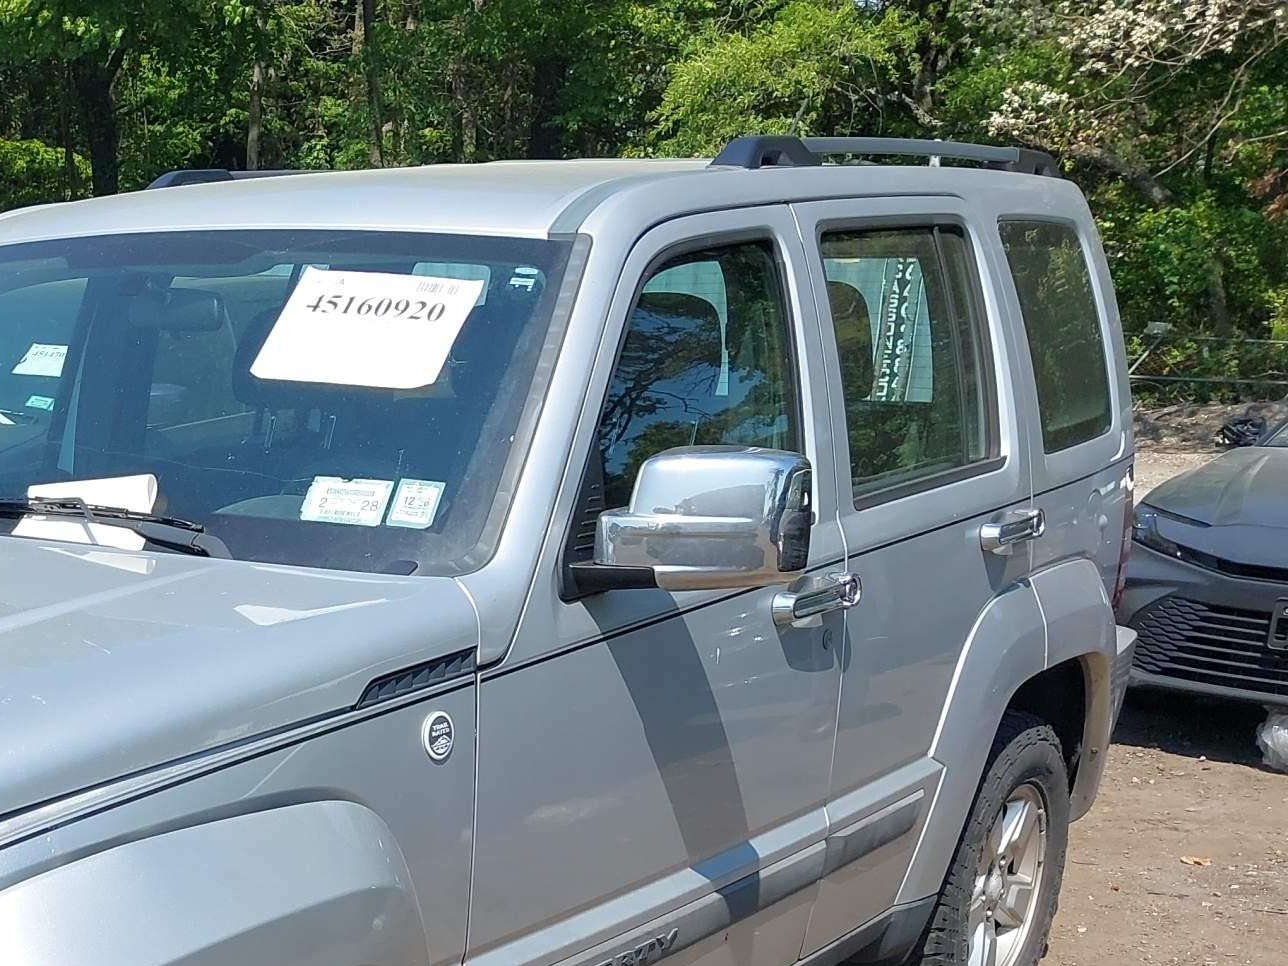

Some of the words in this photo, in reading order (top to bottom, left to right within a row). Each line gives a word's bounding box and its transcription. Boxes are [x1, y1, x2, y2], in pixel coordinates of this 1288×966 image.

[306, 294, 446, 322] 45160920
[432, 721, 449, 731] TRAIL
[431, 728, 450, 737] RATED
